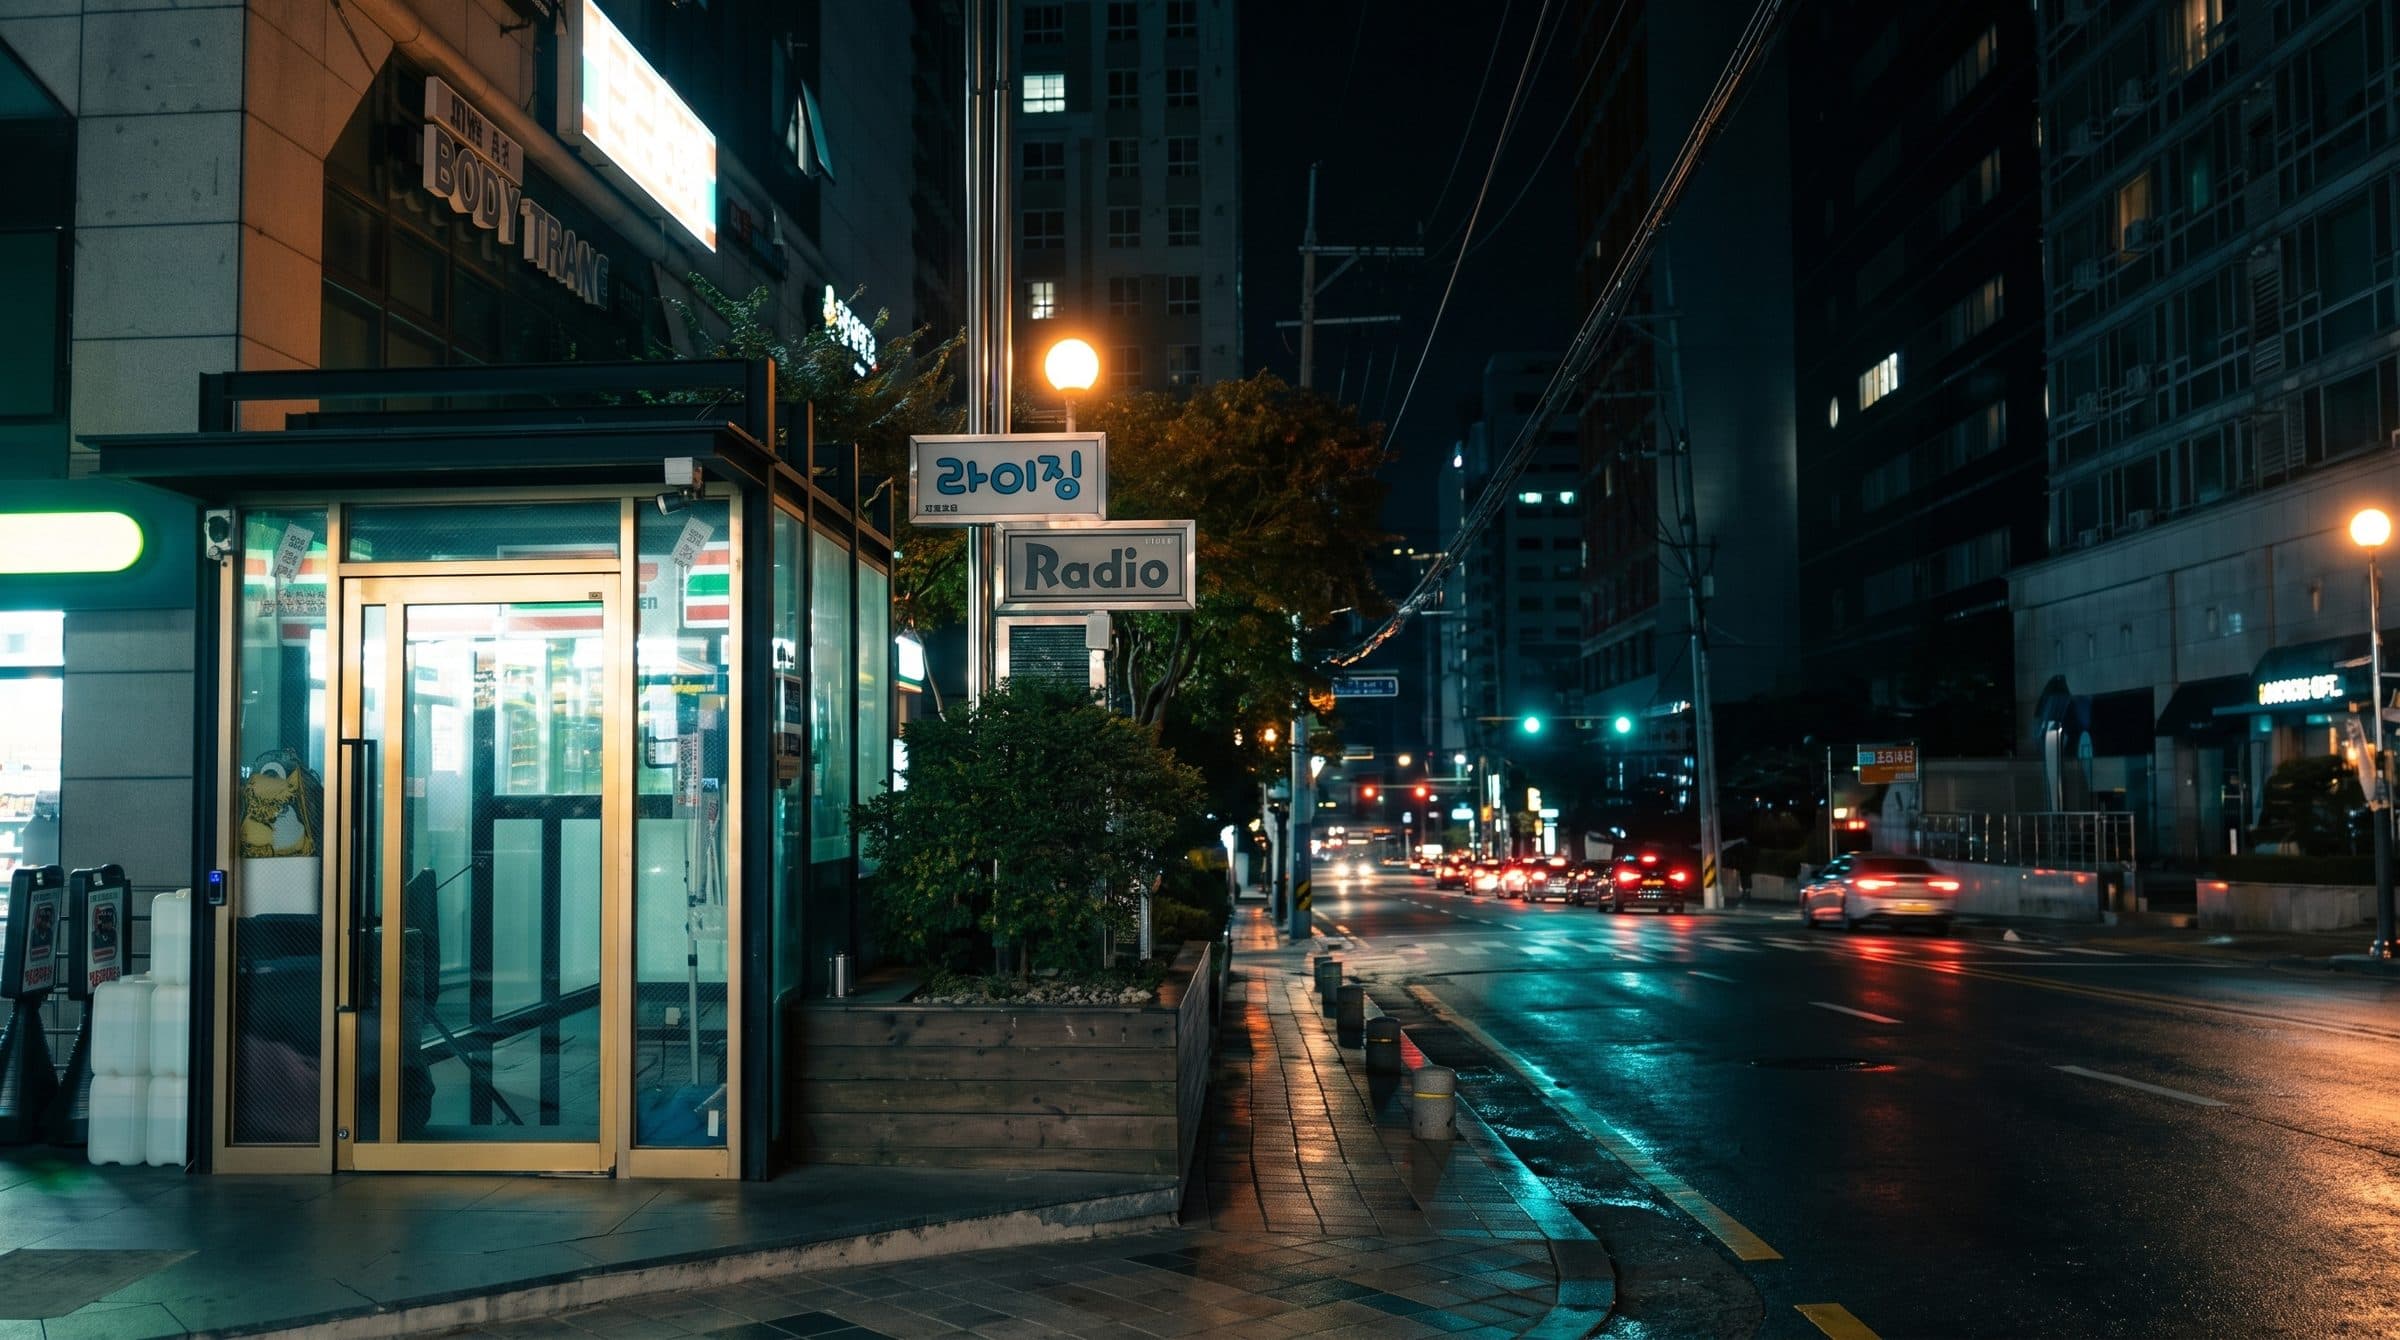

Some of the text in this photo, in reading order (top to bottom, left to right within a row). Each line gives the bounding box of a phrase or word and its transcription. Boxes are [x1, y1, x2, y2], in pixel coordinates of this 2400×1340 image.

[424, 124, 522, 245] BODY
[936, 450, 1082, 500] 라이징
[1025, 542, 1169, 590] Radio
